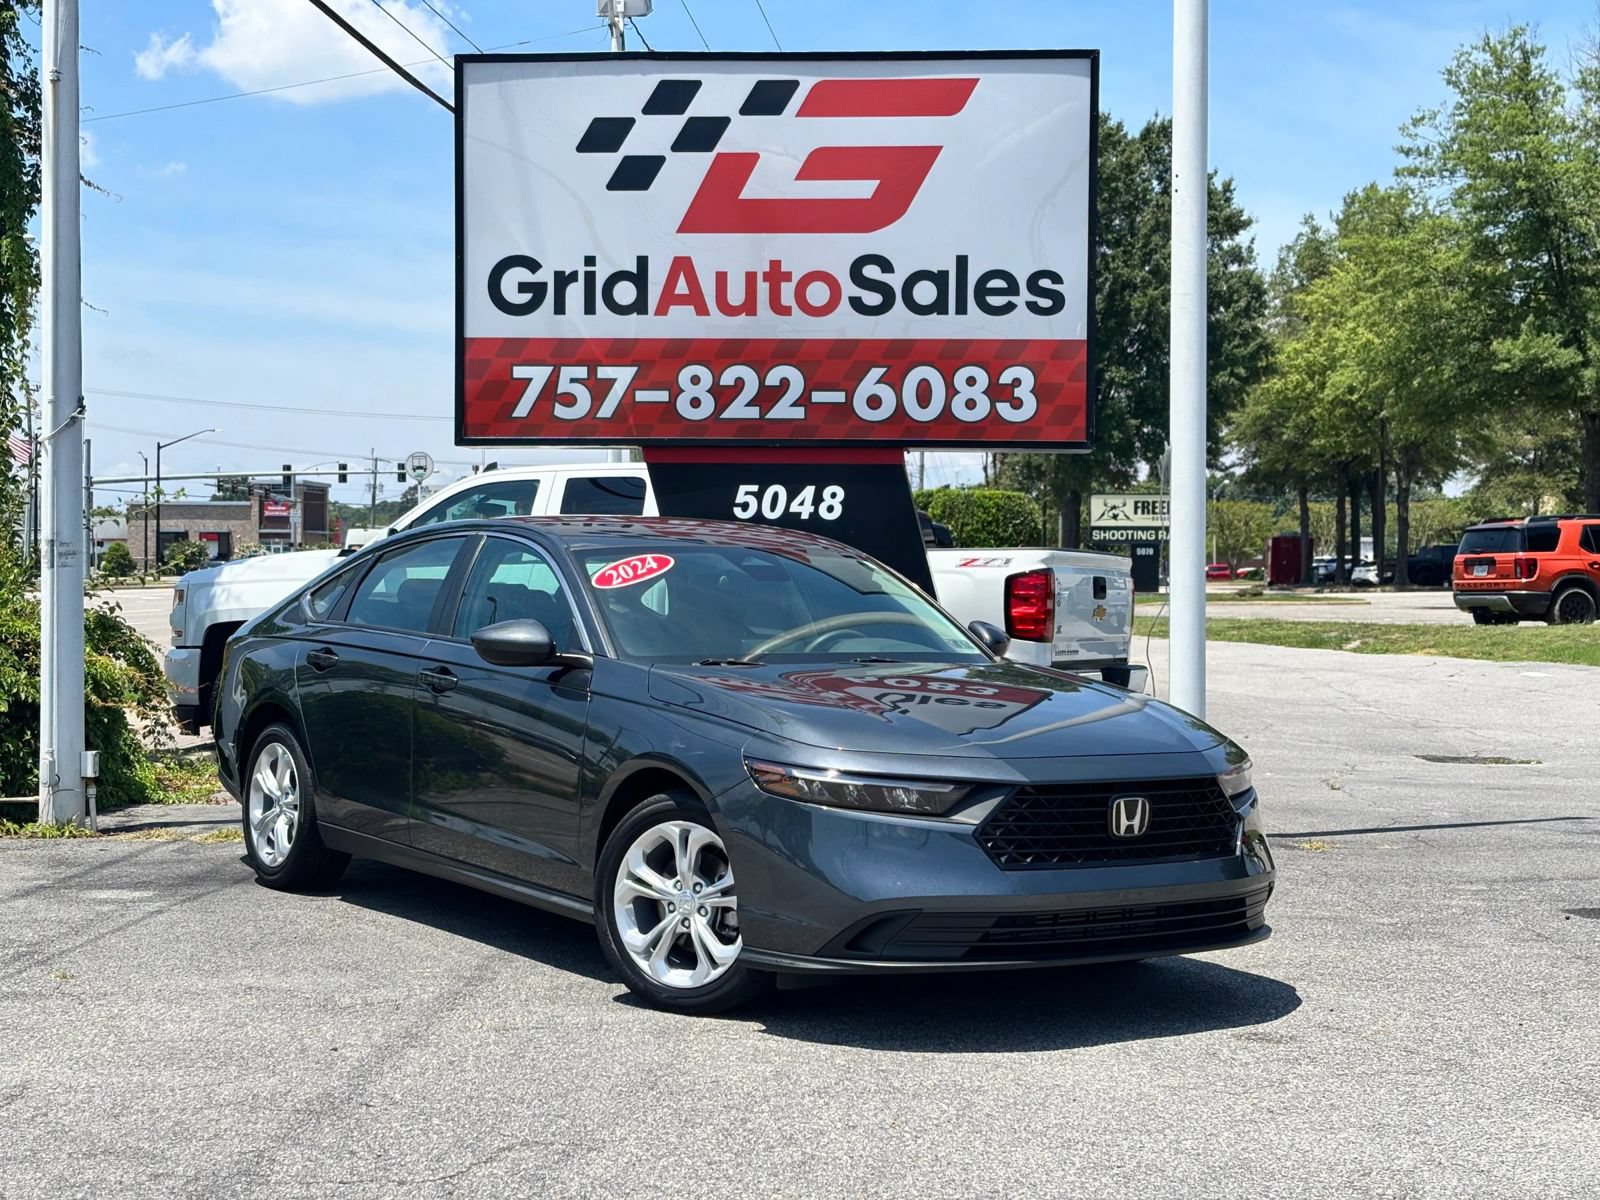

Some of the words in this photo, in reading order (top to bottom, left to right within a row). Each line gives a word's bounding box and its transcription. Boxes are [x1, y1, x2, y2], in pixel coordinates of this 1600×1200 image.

[510, 364, 1039, 422] 757-822-6083
[732, 484, 845, 520] 5048
[1092, 529, 1156, 540] SHOOTING
[605, 556, 658, 586] 2024
